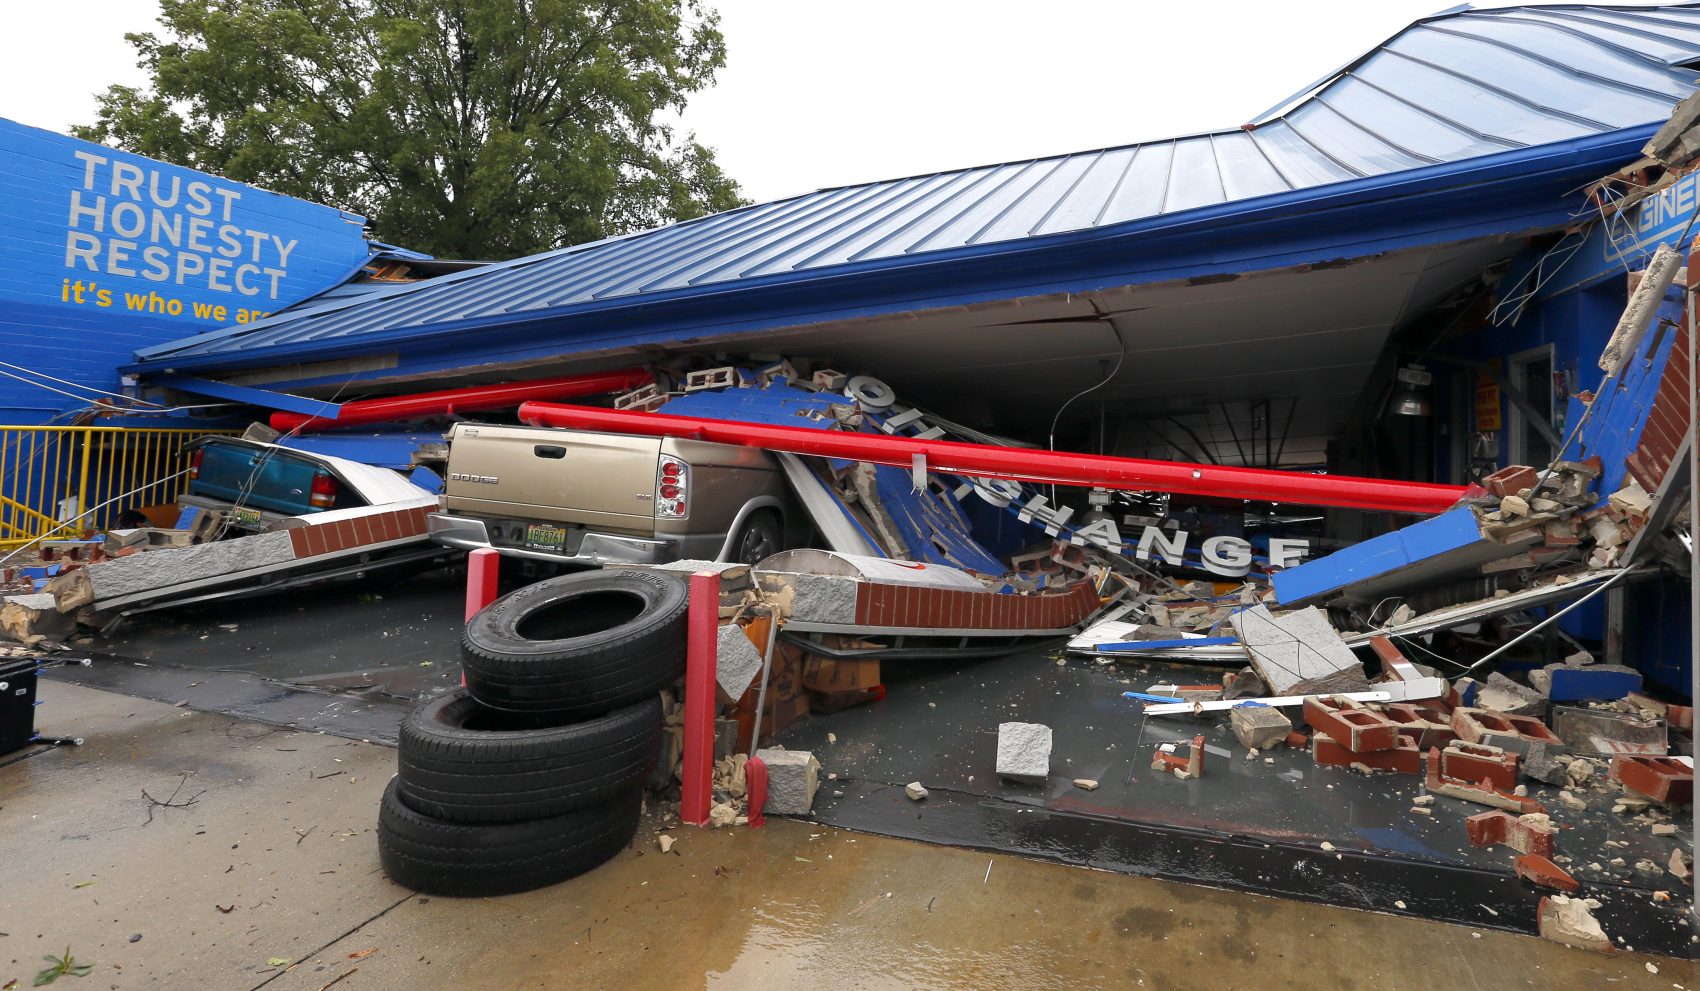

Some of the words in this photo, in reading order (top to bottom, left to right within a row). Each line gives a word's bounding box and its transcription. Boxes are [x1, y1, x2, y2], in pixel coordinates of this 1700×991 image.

[75, 151, 241, 222] TRUST
[68, 191, 298, 268] HONESTY
[65, 231, 286, 299] RESPECT
[61, 278, 112, 307] it's
[125, 291, 183, 316] who
[193, 302, 227, 321] we
[451, 473, 499, 484] DODGE
